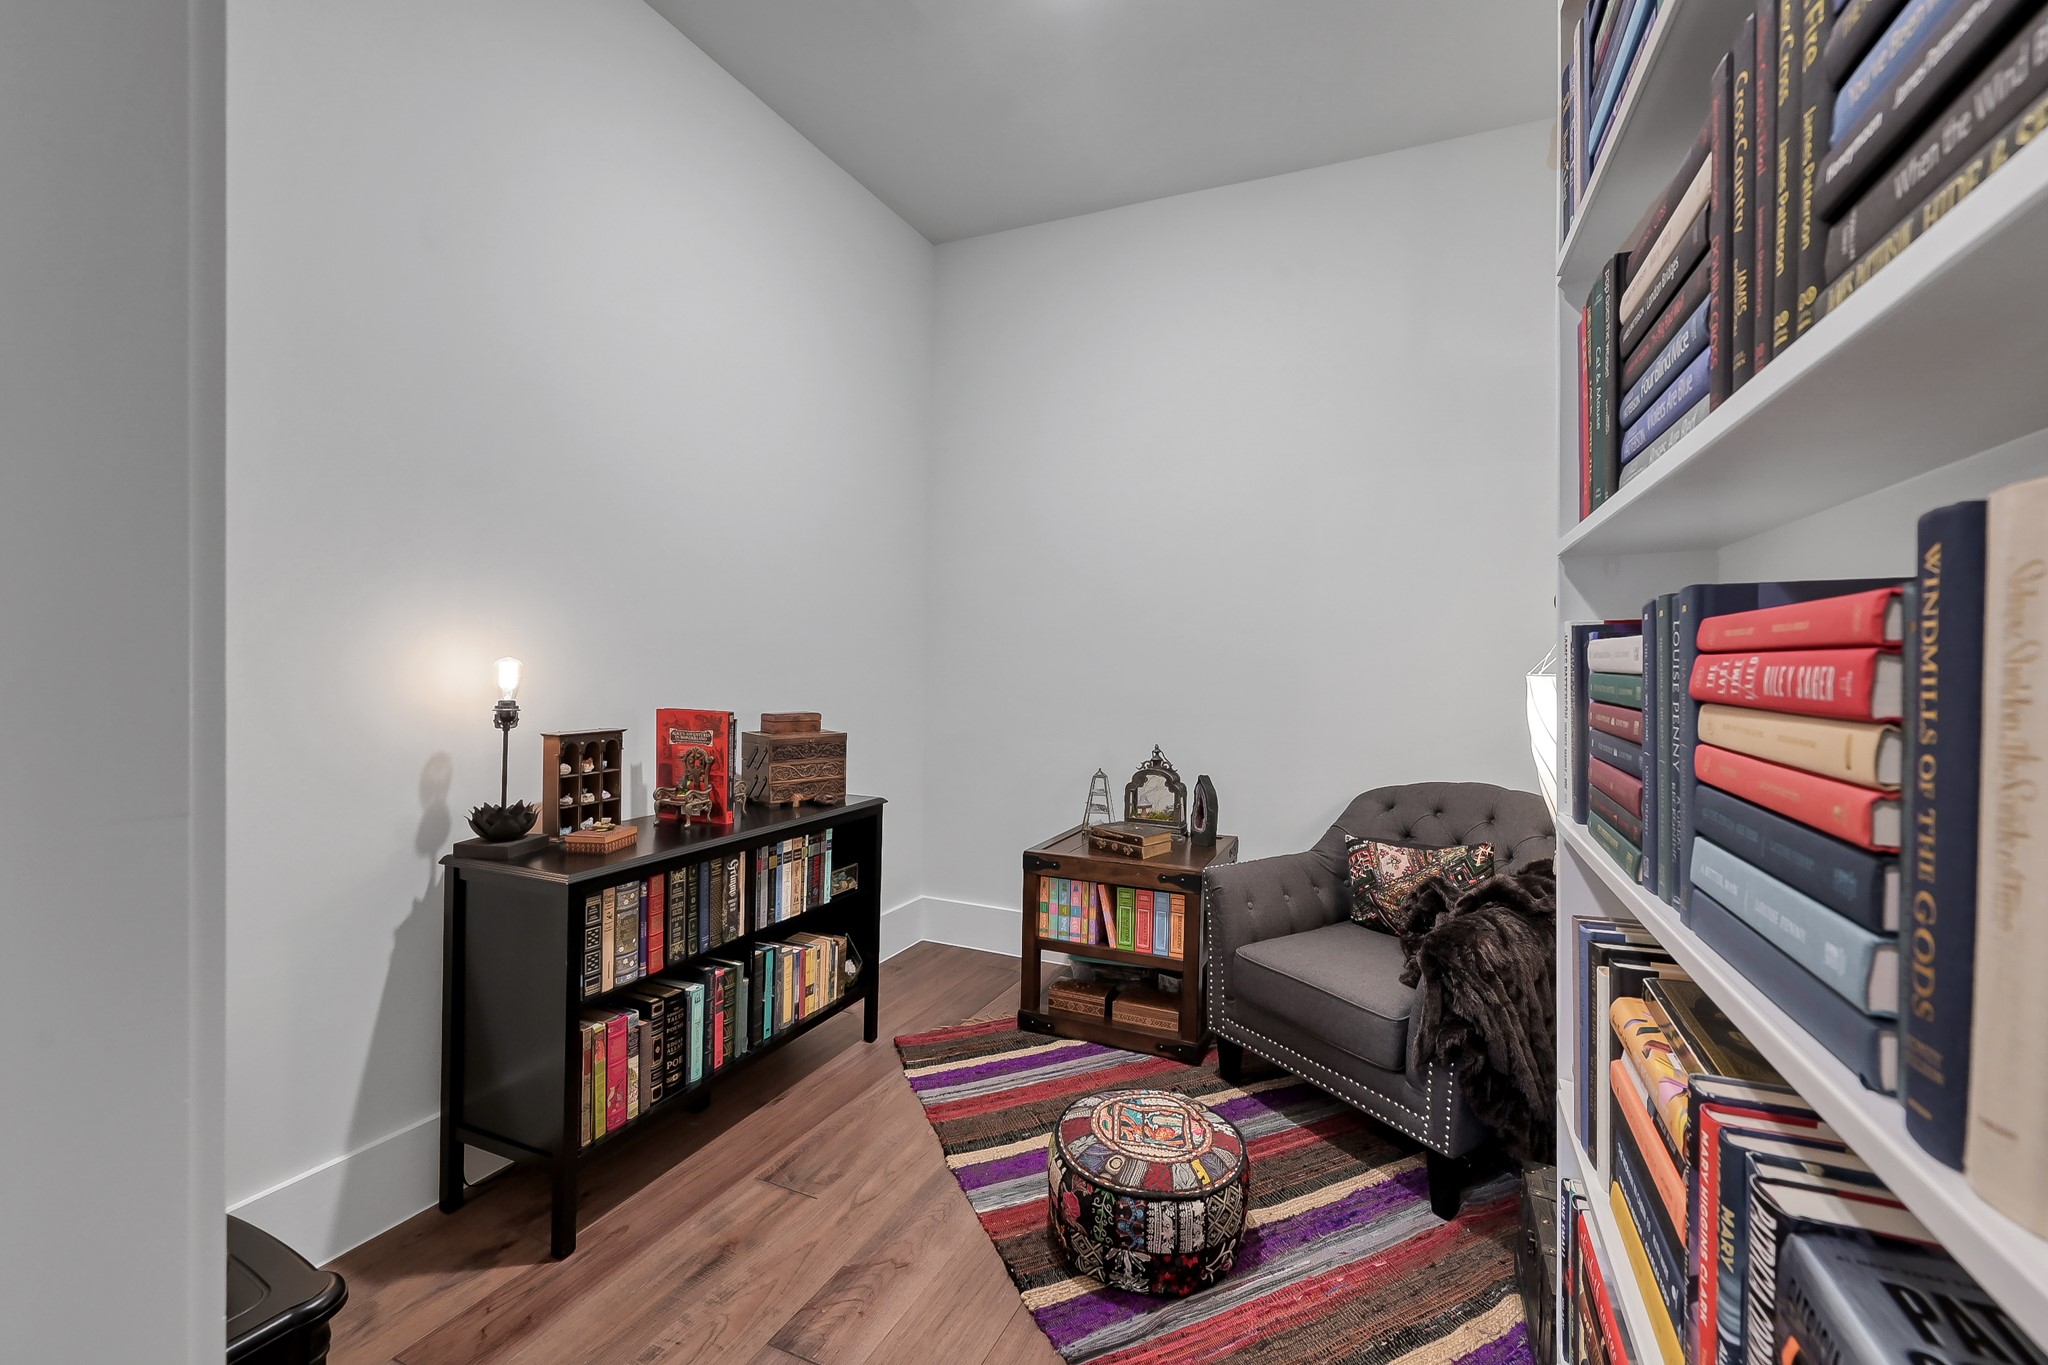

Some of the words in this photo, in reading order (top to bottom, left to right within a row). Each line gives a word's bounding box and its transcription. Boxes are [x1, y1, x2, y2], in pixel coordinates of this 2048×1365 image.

[1734, 70, 1749, 141] Cross
[1803, 105, 1817, 166] James
[1734, 137, 1748, 233] Country
[1778, 137, 1790, 194] James
[1776, 191, 1789, 278] Patterson
[1801, 161, 1815, 251] Patterson
[1646, 281, 1663, 310] London
[1661, 256, 1680, 288] Bridges
[1711, 234, 1719, 306] DOUBLE
[1736, 269, 1747, 317] JAMES
[1596, 373, 1602, 383] &
[1641, 369, 1656, 398] Four
[1671, 330, 1689, 363] Mice
[1919, 541, 1943, 746] WINDMILLS
[1796, 666, 1835, 702] SAGER
[1672, 701, 1680, 772] PENNY
[1918, 753, 1938, 801] OF
[1916, 806, 1938, 884] THE
[1911, 889, 1938, 1023] GODS
[666, 1055, 684, 1070] POE
[1700, 1129, 1710, 1184] MARY
[1699, 1183, 1709, 1261] HIGGINS
[1721, 1204, 1735, 1274] MARY
[1749, 1193, 1777, 1309] PATRICIA
[1699, 1262, 1709, 1326] CLARK
